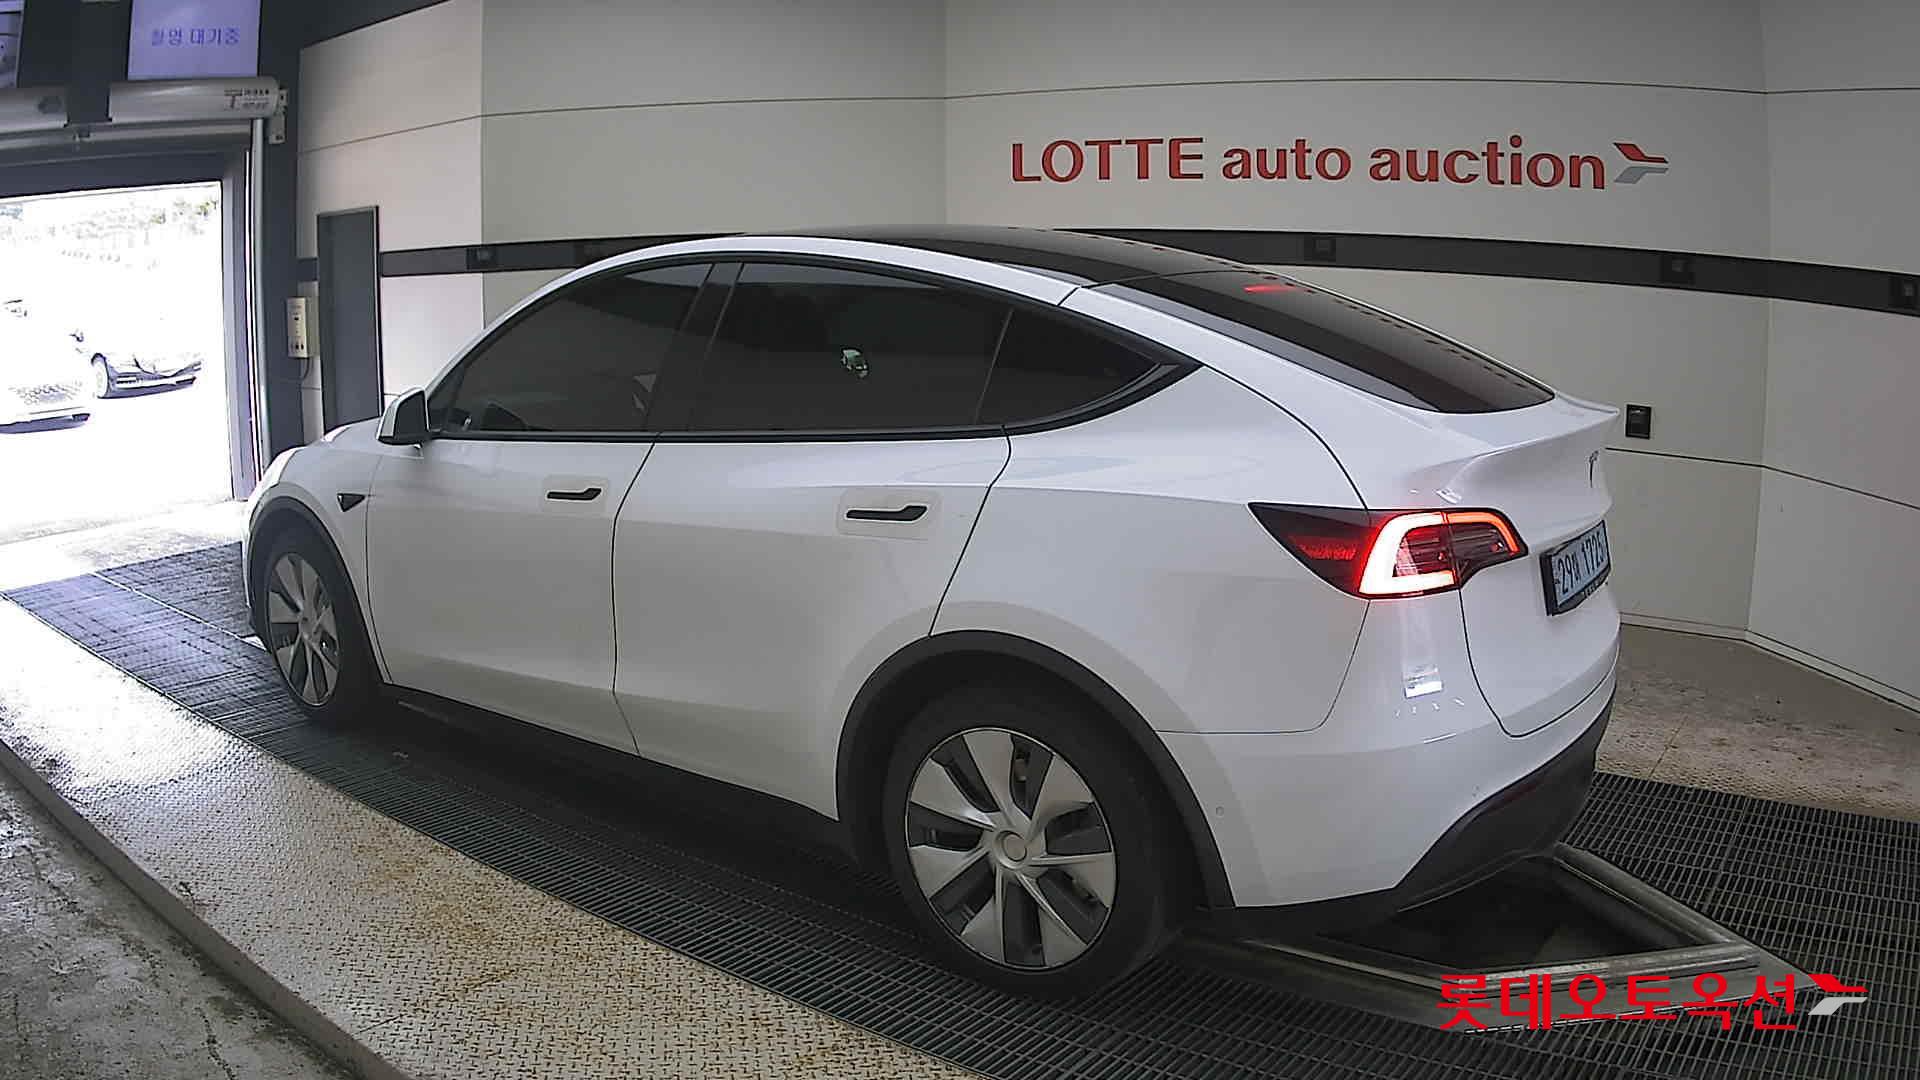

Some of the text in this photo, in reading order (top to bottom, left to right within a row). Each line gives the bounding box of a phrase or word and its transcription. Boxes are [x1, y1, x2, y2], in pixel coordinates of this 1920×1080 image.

[190, 26, 240, 45] 대기중
[1012, 135, 1606, 190] LOTTE auto auction
